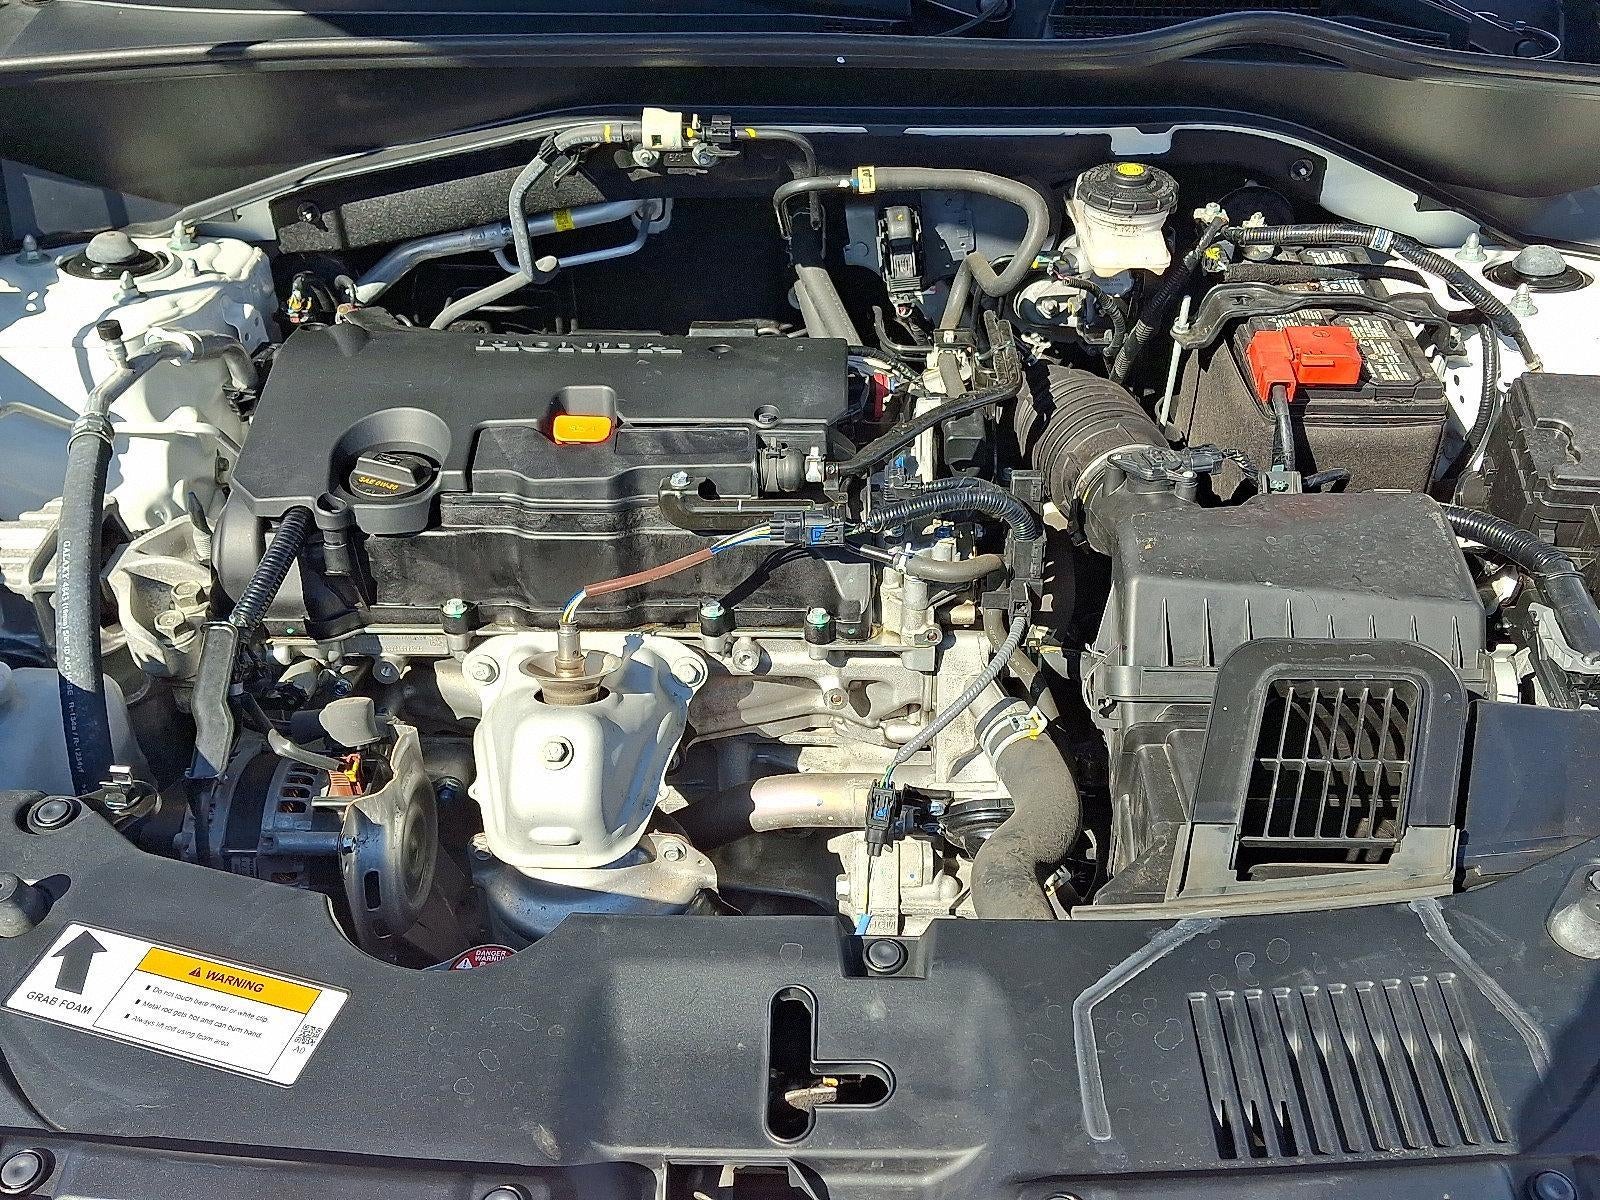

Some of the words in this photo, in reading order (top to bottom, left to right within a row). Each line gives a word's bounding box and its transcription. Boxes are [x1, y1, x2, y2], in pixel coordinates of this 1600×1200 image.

[358, 476, 375, 485] SAE
[61, 540, 71, 579] GALAXY
[65, 671, 74, 696] HOSE
[68, 701, 78, 731] R-134a
[205, 970, 265, 993] WARNING
[26, 991, 59, 1006] GRAB
[59, 999, 93, 1015] FOAM
[142, 1000, 162, 1010] Metal
[173, 1010, 187, 1018] gets
[189, 1013, 201, 1021] hot
[200, 1017, 214, 1025] and
[228, 1025, 243, 1033] burn
[152, 986, 163, 994] Do
[163, 990, 175, 998] not
[175, 993, 193, 1002] touch
[194, 998, 209, 1006] bare
[210, 1002, 230, 1012] metal
[238, 1011, 255, 1020] white
[131, 1015, 155, 1027] Always
[155, 1021, 165, 1029] lift
[177, 1028, 195, 1039] using
[196, 1032, 214, 1042] foam
